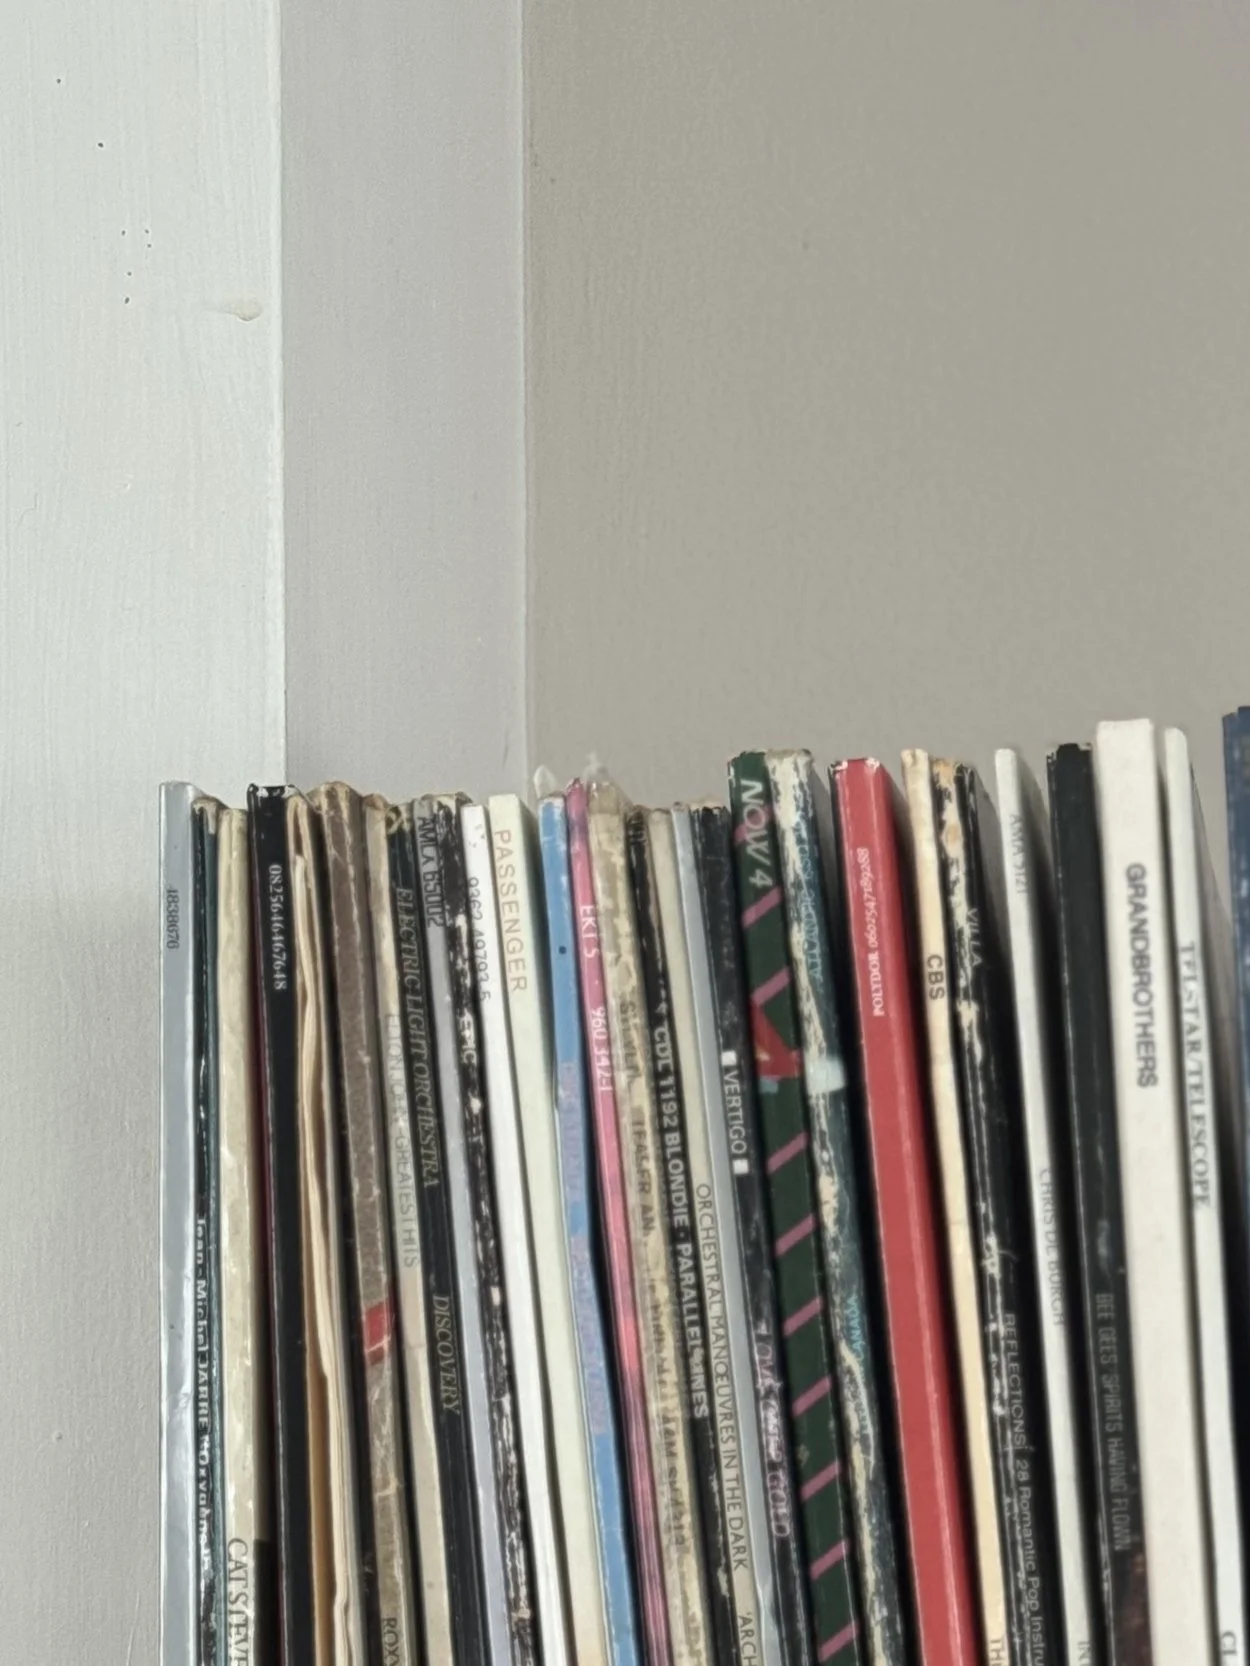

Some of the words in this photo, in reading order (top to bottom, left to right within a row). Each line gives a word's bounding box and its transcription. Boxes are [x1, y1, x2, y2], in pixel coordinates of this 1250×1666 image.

[739, 779, 770, 868] NOW
[422, 872, 445, 928] 65002
[749, 869, 772, 887] 4
[266, 864, 287, 990] 0825646467648
[395, 887, 418, 989] ELECTRIC
[493, 830, 527, 992] PASSENGER
[579, 905, 599, 941] EKT
[589, 1007, 609, 1037] 960
[867, 954, 885, 1016] POLYDOR
[925, 954, 945, 1000] CBS
[1124, 863, 1158, 1087] GRANDBROTHERS
[404, 994, 426, 1060] LIGHT
[652, 1026, 674, 1070] CDL
[409, 1063, 440, 1189] ORCHESTRA
[657, 1078, 680, 1128] 1192
[723, 1069, 747, 1153] VERTIGO
[661, 1132, 689, 1227] BLONDIE
[693, 1184, 723, 1311] ORCHESTRAL
[675, 1243, 703, 1353] PARALLEL
[1094, 1293, 1114, 1320] BEE
[430, 1295, 461, 1416] DISCOVERY
[1097, 1327, 1117, 1365] GEES
[706, 1315, 735, 1445] MANŒUVRES
[1002, 1313, 1026, 1445] REFLECTIONS
[720, 1449, 737, 1469] IN
[1015, 1459, 1030, 1481] 28
[1106, 1438, 1128, 1492] HAVING
[724, 1474, 742, 1511] THE
[766, 1473, 790, 1537] GOLD
[1109, 1498, 1133, 1550] FLOWN
[727, 1517, 749, 1571] DARK
[1017, 1486, 1039, 1572] Romantic
[226, 1538, 248, 1589] CAT
[1024, 1577, 1041, 1611] Pop
